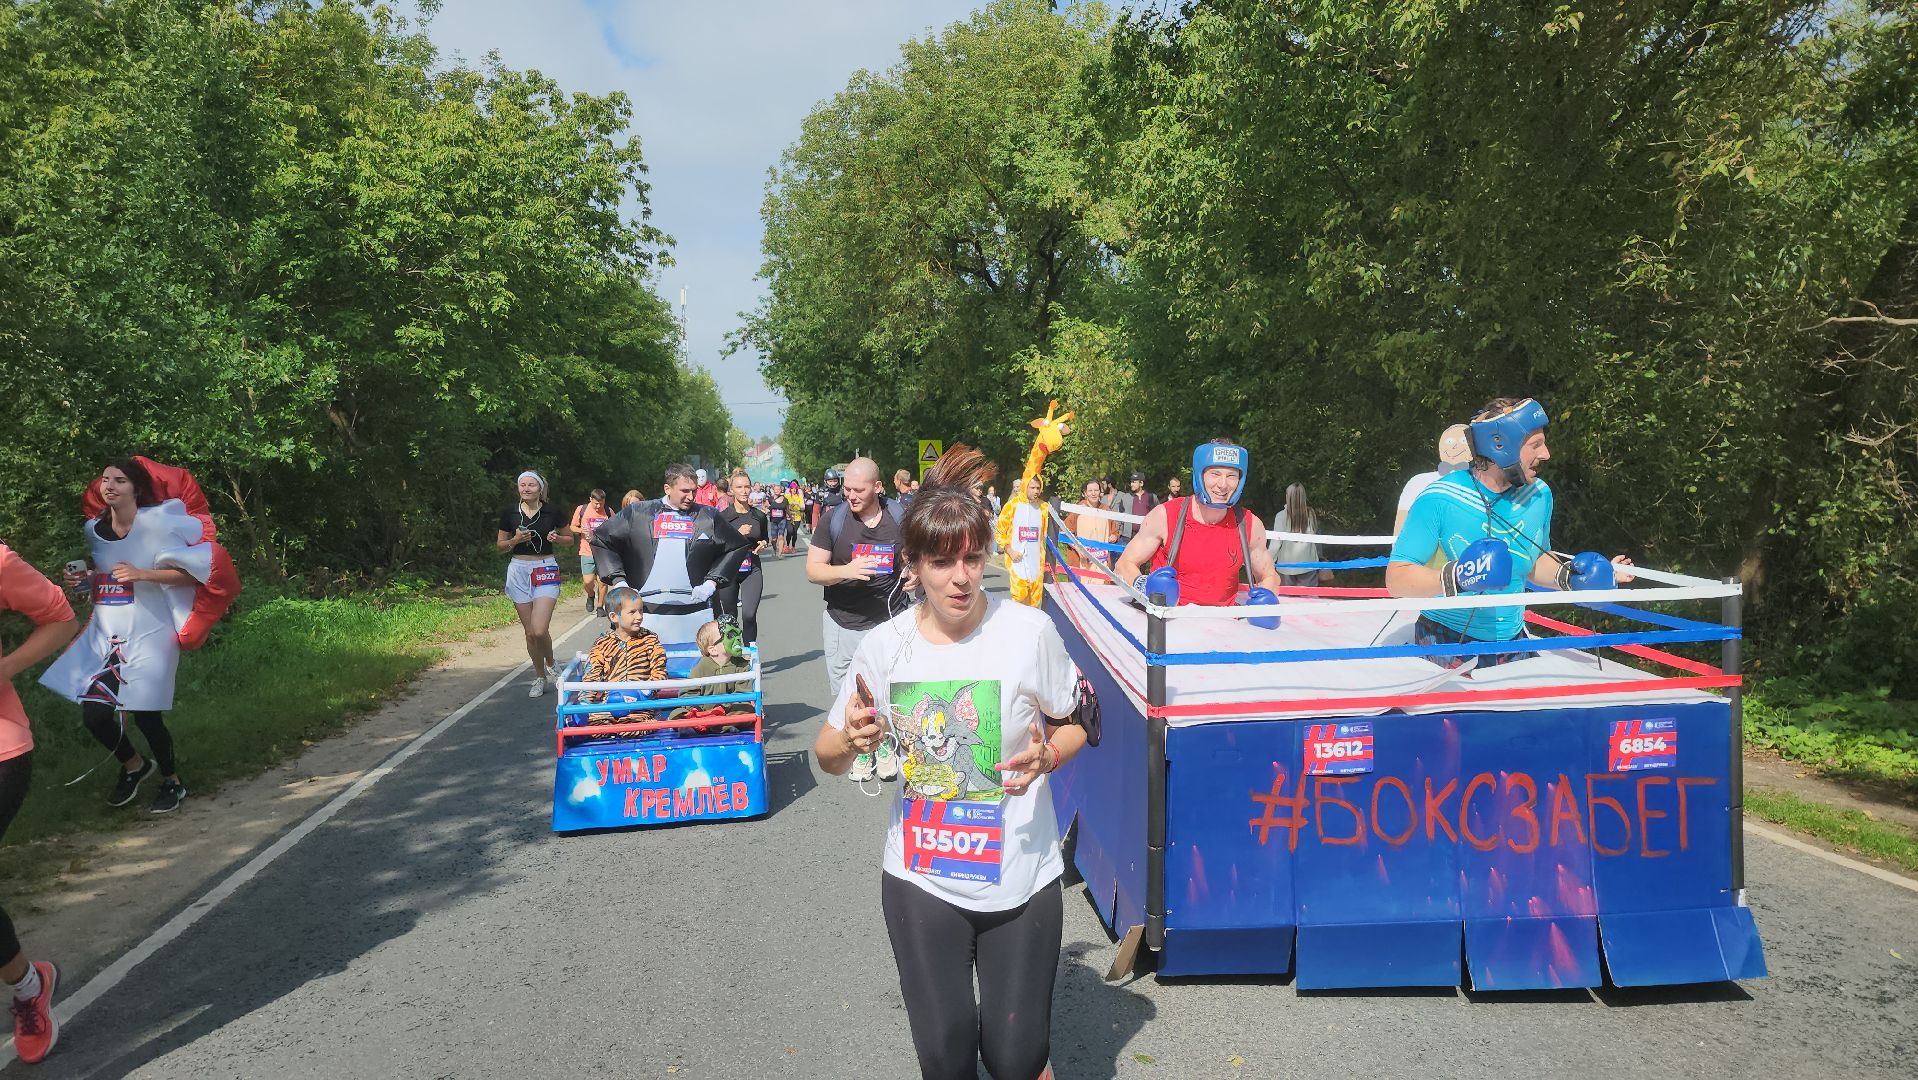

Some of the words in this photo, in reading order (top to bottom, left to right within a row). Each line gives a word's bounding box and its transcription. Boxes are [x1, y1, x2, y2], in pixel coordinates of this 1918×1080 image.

[1214, 448, 1239, 457] GREEN
[1456, 554, 1492, 582] РЭЙ
[98, 584, 124, 594] 7175
[1461, 573, 1488, 587] СПОРТ
[1313, 740, 1364, 759] 13612
[1619, 736, 1667, 754] 6854
[596, 754, 668, 786] УМАР
[623, 776, 749, 819] КРЕМЛЁВ
[1248, 771, 1718, 857] #БОКСЗАБЕГ
[911, 826, 989, 856] 13507
